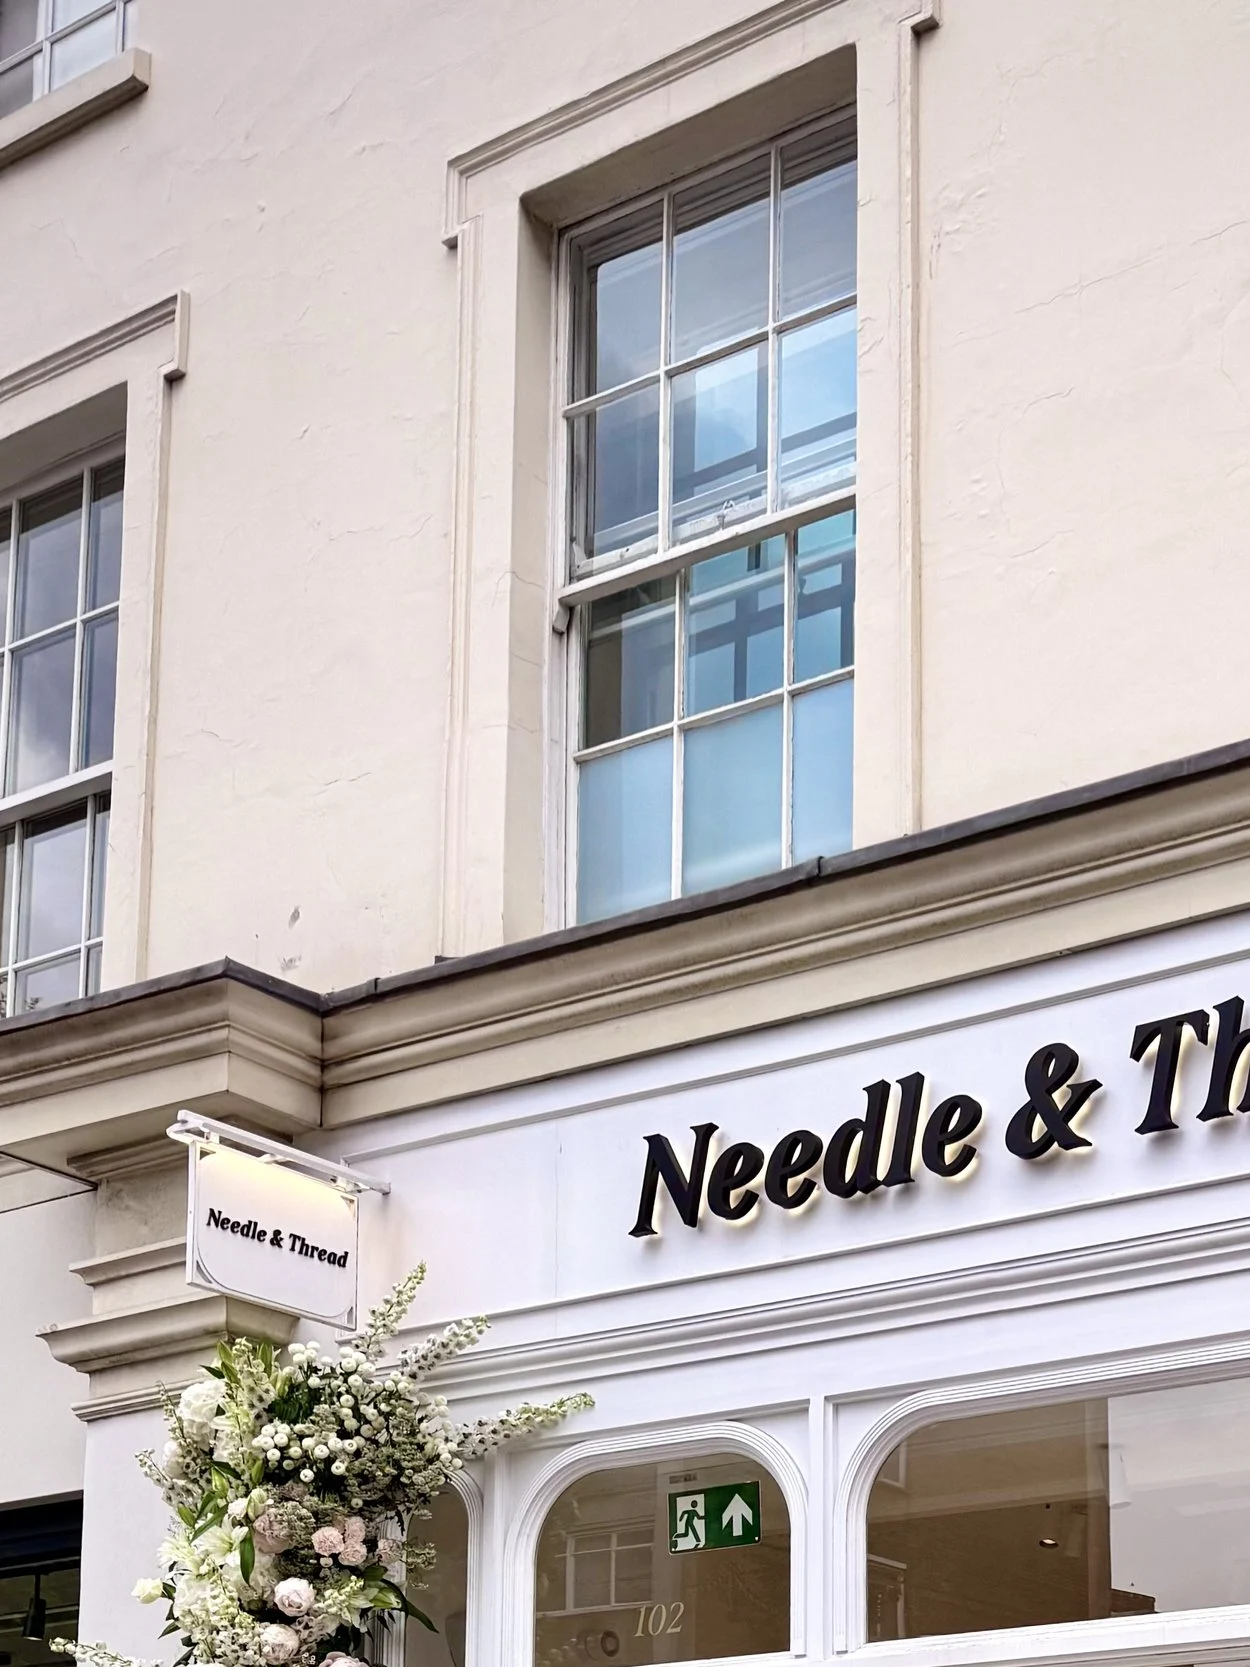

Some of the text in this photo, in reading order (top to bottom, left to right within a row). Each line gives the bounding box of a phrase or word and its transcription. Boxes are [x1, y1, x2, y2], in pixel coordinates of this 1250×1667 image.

[629, 1072, 982, 1239] Needle
[1005, 1042, 1102, 1162] &
[206, 1207, 349, 1268] Needle & Thread
[633, 1601, 685, 1638] 102
